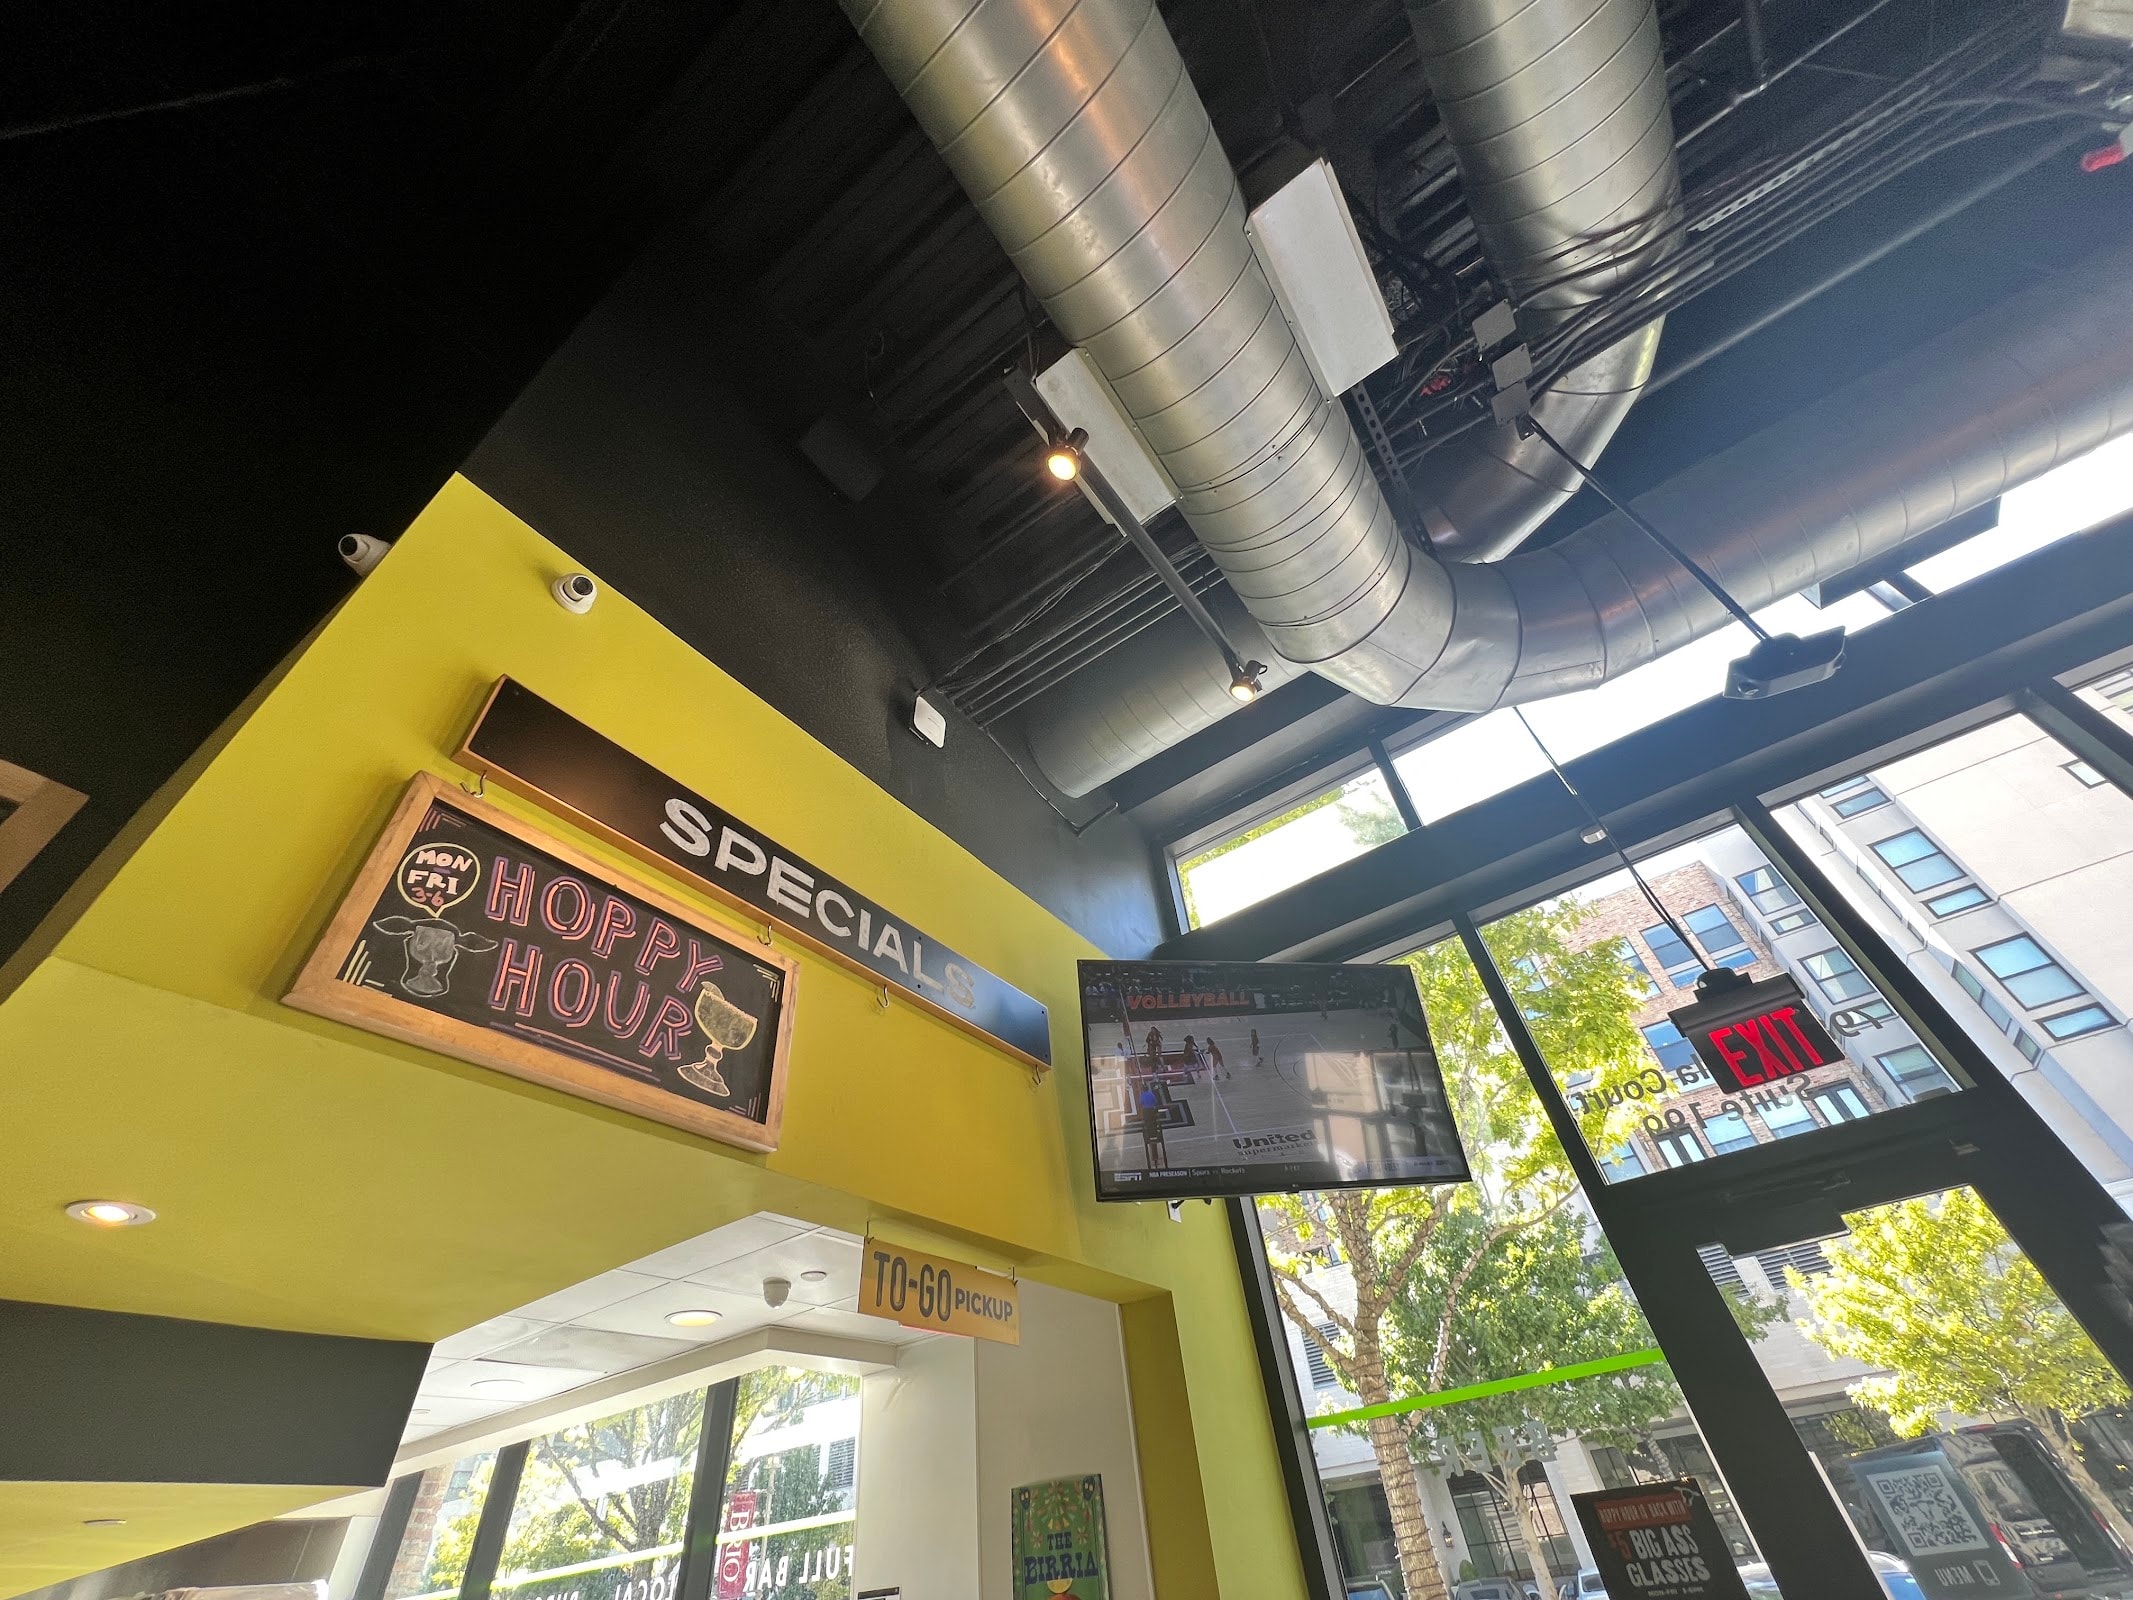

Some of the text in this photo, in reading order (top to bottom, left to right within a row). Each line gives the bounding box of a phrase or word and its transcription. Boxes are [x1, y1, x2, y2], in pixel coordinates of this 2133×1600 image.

[416, 850, 473, 872] MON
[407, 869, 459, 895] FRI
[412, 887, 444, 906] 3-6
[660, 798, 975, 1008] SPECIALS
[485, 856, 723, 993] HOPPY
[488, 938, 693, 1060] HOUR
[1127, 992, 1249, 1010] VOLLEYBALL
[1708, 1007, 1824, 1087] EXIT
[1232, 1130, 1316, 1149] United
[1114, 1172, 1142, 1182] ESPN
[1191, 1168, 1210, 1176] Spurs
[874, 1251, 1013, 1322] TO-GO PICKUP
[1047, 1532, 1072, 1550] THE
[1629, 1528, 1660, 1559] BIG
[1662, 1524, 1699, 1556] ASS
[1024, 1551, 1098, 1585] BIRRIA
[1625, 1557, 1710, 1587] GLASSES
